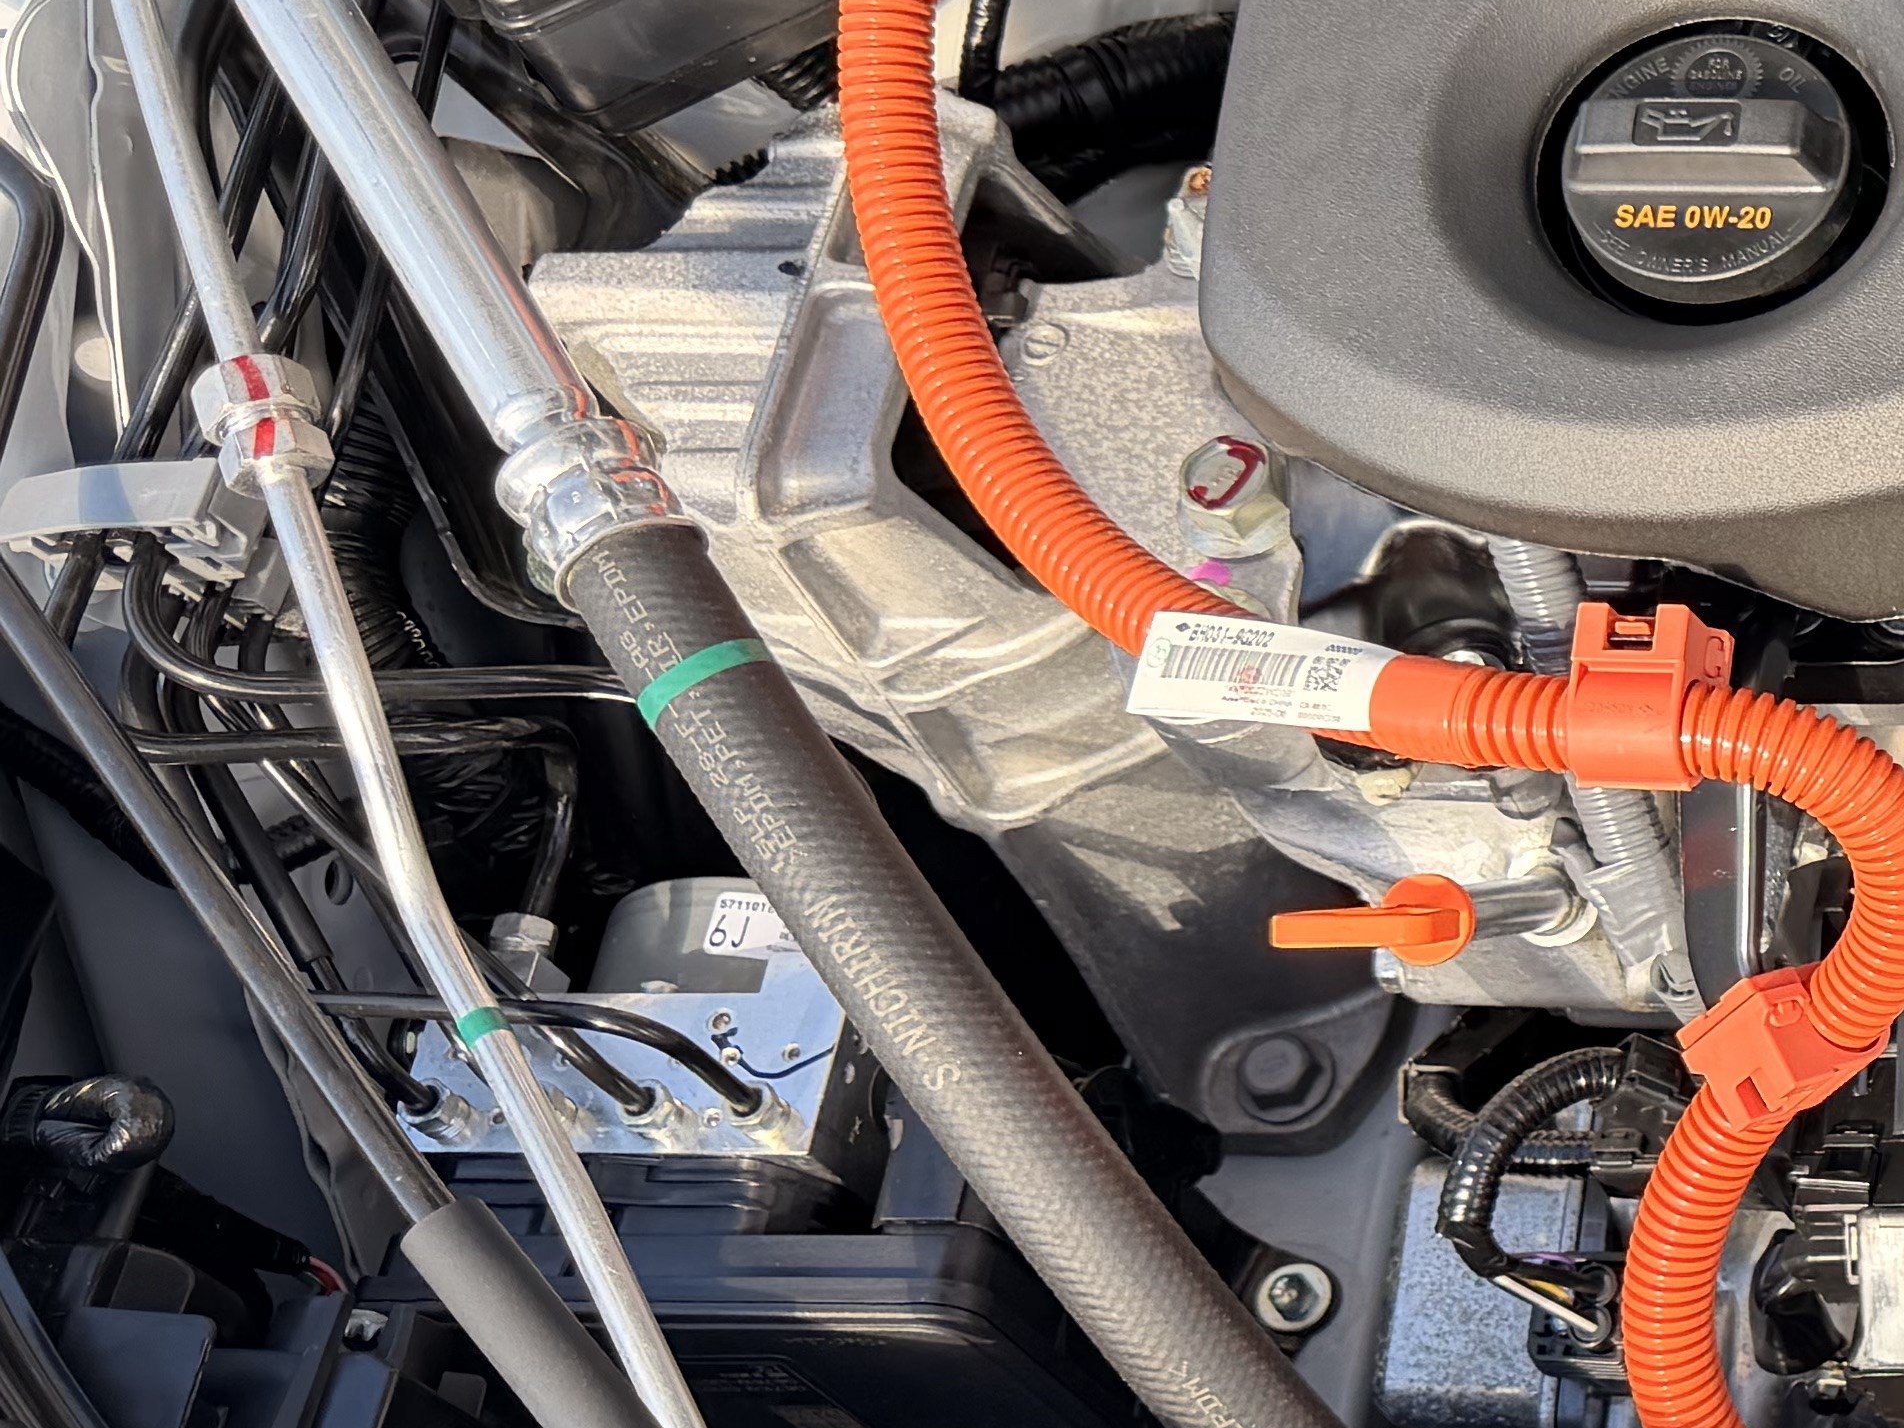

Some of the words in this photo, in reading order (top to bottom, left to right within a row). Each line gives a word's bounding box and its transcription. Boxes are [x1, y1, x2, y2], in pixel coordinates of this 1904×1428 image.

[1779, 67, 1806, 94] OIL
[1614, 204, 1677, 228] SAE
[1685, 205, 1772, 230] 0W-20
[707, 910, 750, 950] 6J
